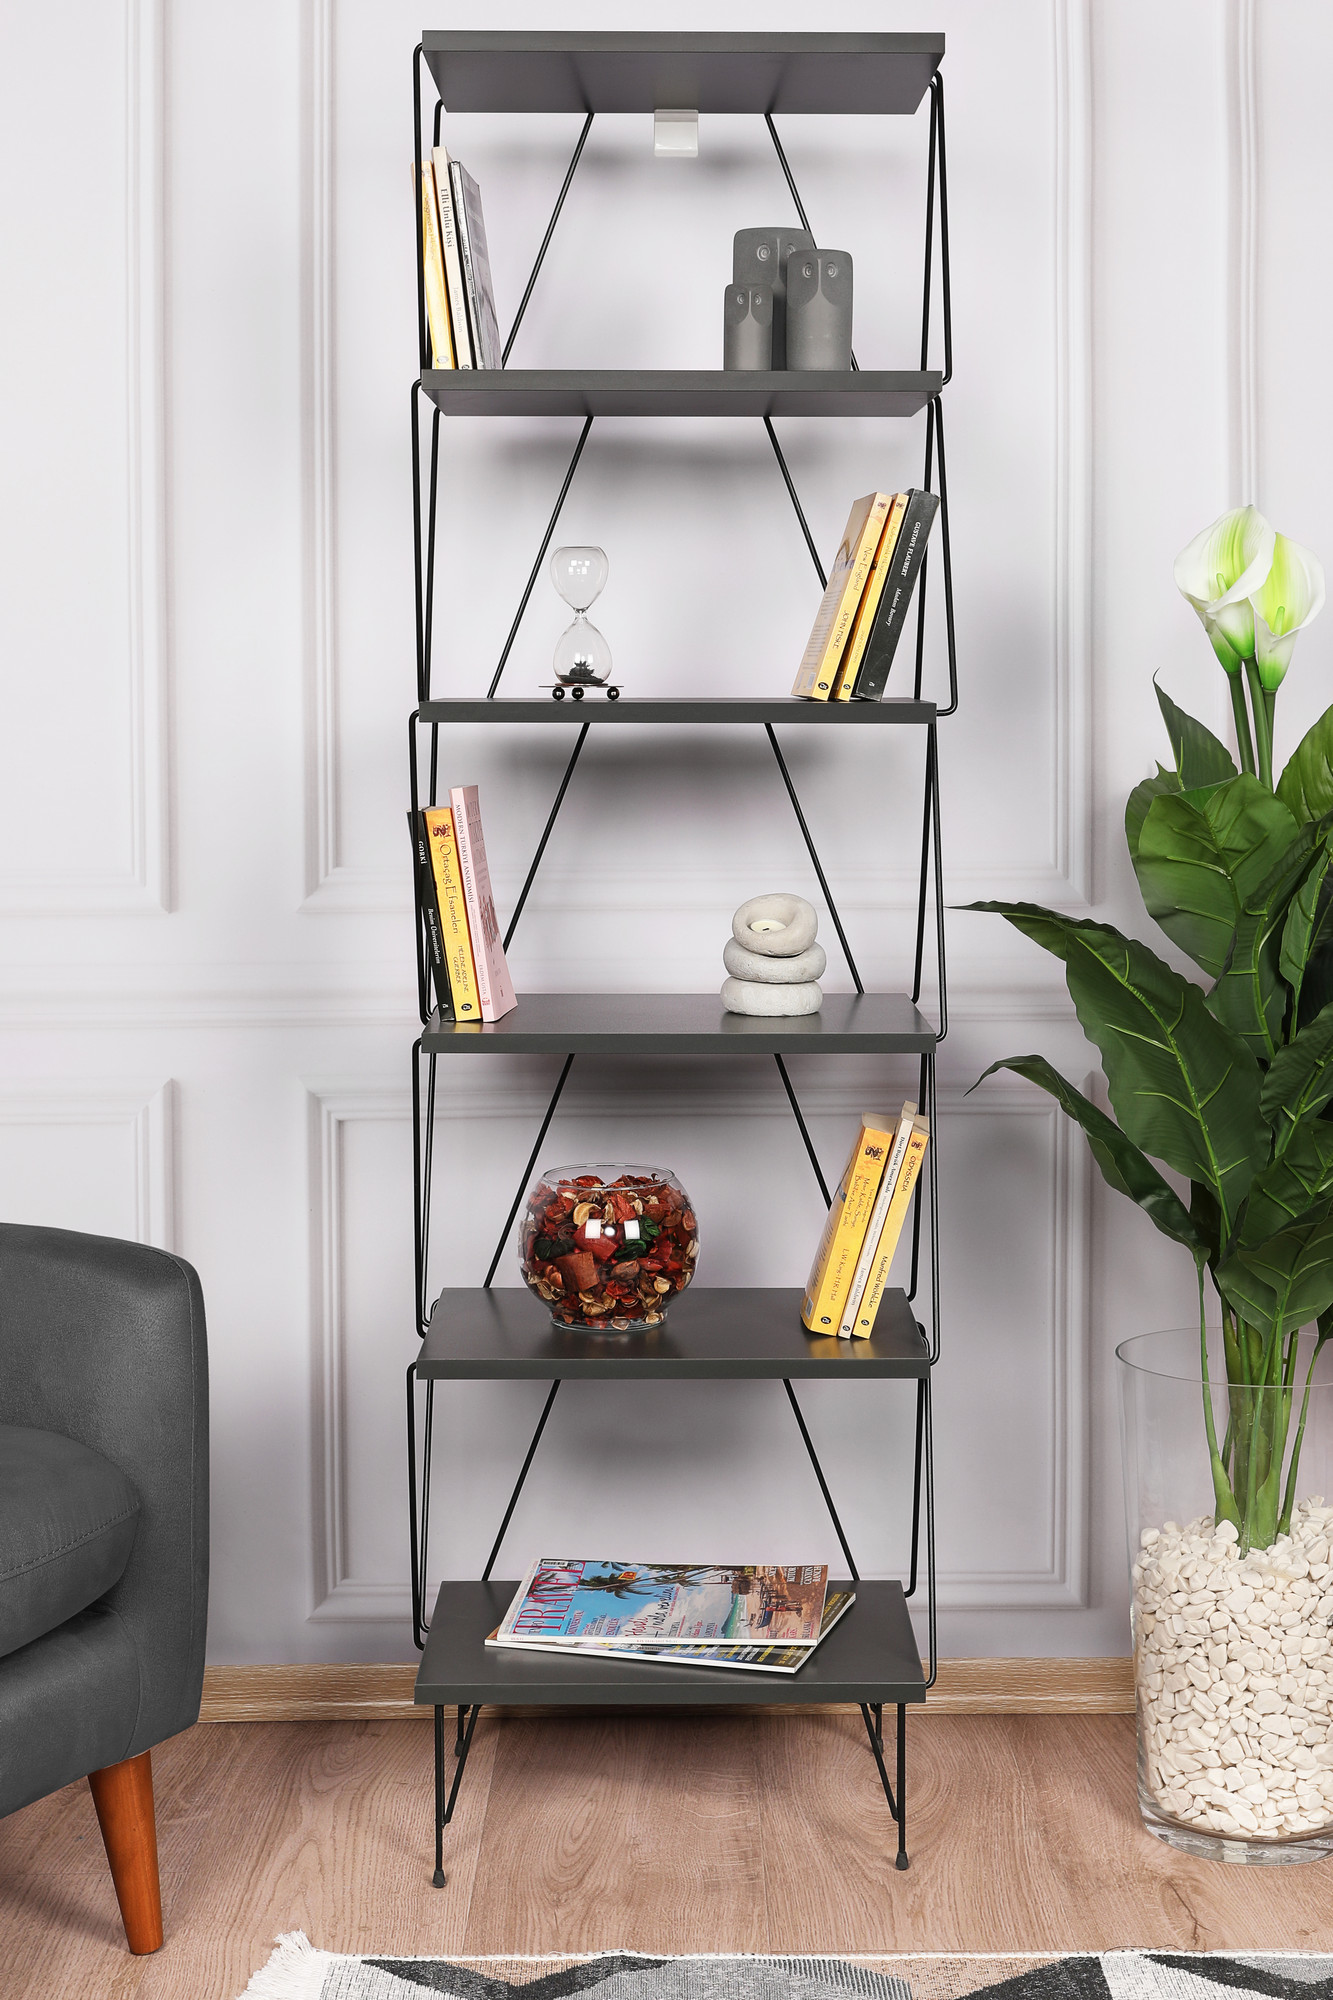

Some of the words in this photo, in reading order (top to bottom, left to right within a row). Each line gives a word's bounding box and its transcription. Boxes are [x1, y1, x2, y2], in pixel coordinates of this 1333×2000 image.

[440, 188, 448, 203] Elli
[442, 205, 454, 228] Ünlü
[445, 230, 454, 247] Kişi
[909, 521, 921, 547] GUSTAVE
[861, 547, 872, 562] New
[901, 547, 914, 576] FLAUBERT
[853, 562, 868, 590] England
[892, 587, 902, 607] Madam
[839, 610, 850, 629] JOHN
[885, 607, 896, 626] Bovary
[833, 630, 844, 649] FISKE
[455, 804, 464, 834] MODERN
[439, 844, 453, 885] Ortaçağ
[445, 885, 461, 934] Efsaneleri
[457, 945, 466, 969] HELENE
[902, 1155, 916, 1192] ODYSSEIA
[876, 1256, 888, 1282] Manfred
[513, 1560, 586, 1633] TRAVEL
